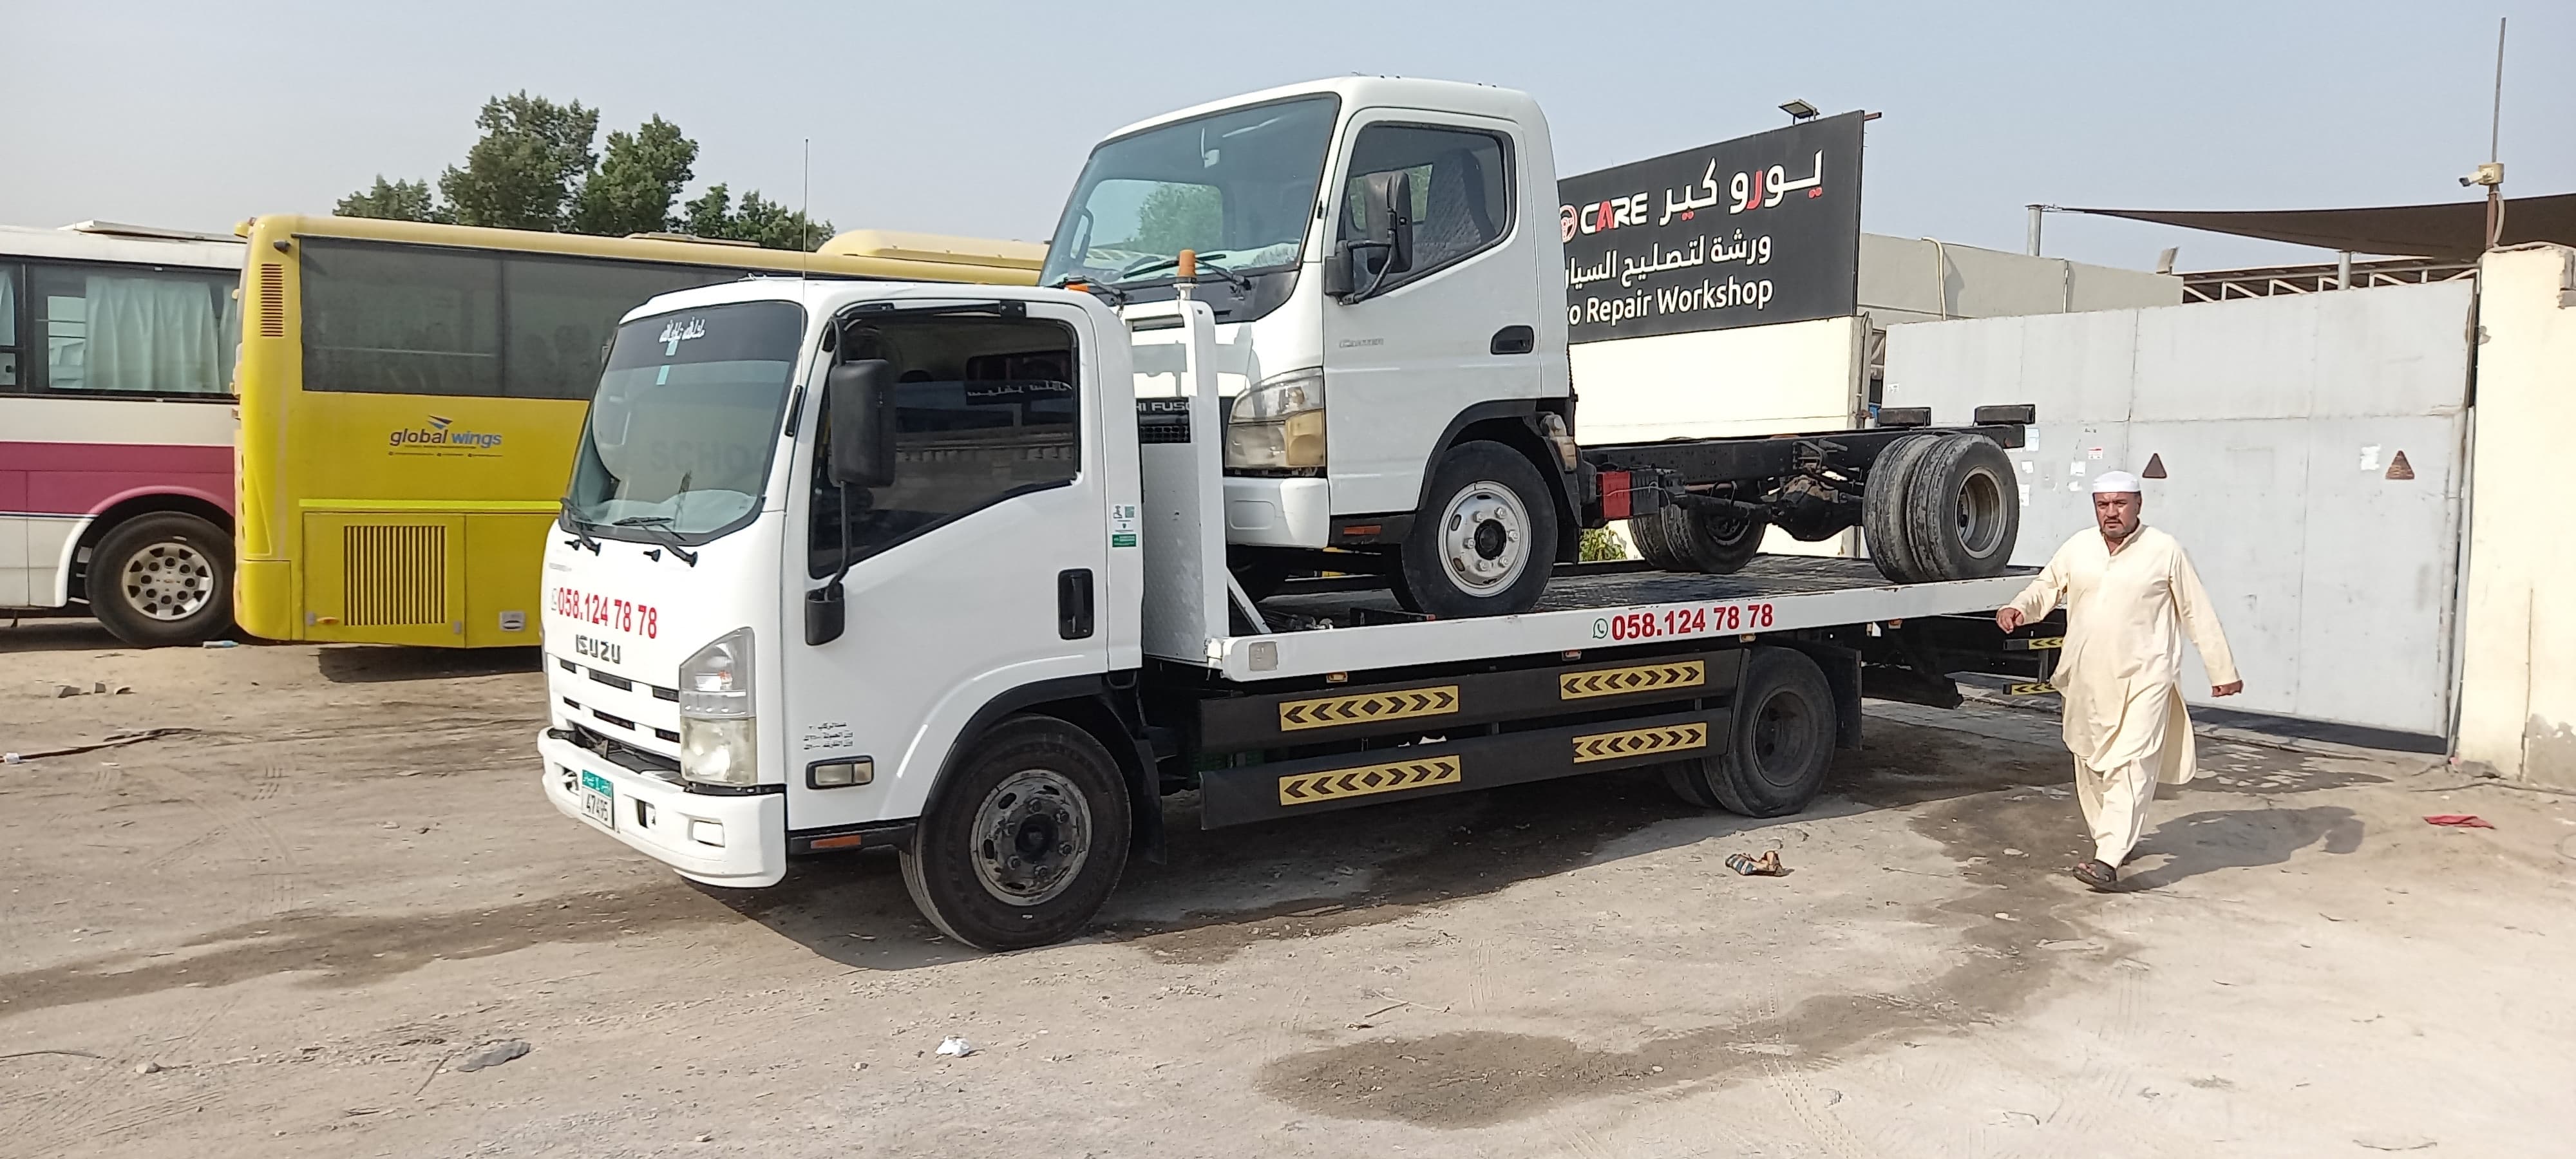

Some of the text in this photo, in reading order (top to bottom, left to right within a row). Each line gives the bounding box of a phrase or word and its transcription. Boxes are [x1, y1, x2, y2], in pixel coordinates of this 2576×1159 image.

[1659, 149, 1824, 227] يورو كير
[1580, 191, 1649, 234] CARE
[1620, 235, 1705, 288] لتصليح
[1710, 228, 1772, 265] ورشة
[1586, 288, 1653, 326] Repair
[1656, 274, 1774, 314] Workshop
[390, 428, 502, 449] global wings
[558, 587, 657, 639] 058.124 78 78
[1612, 603, 1773, 641] 058.124 78 78
[575, 634, 621, 664] ISUZU
